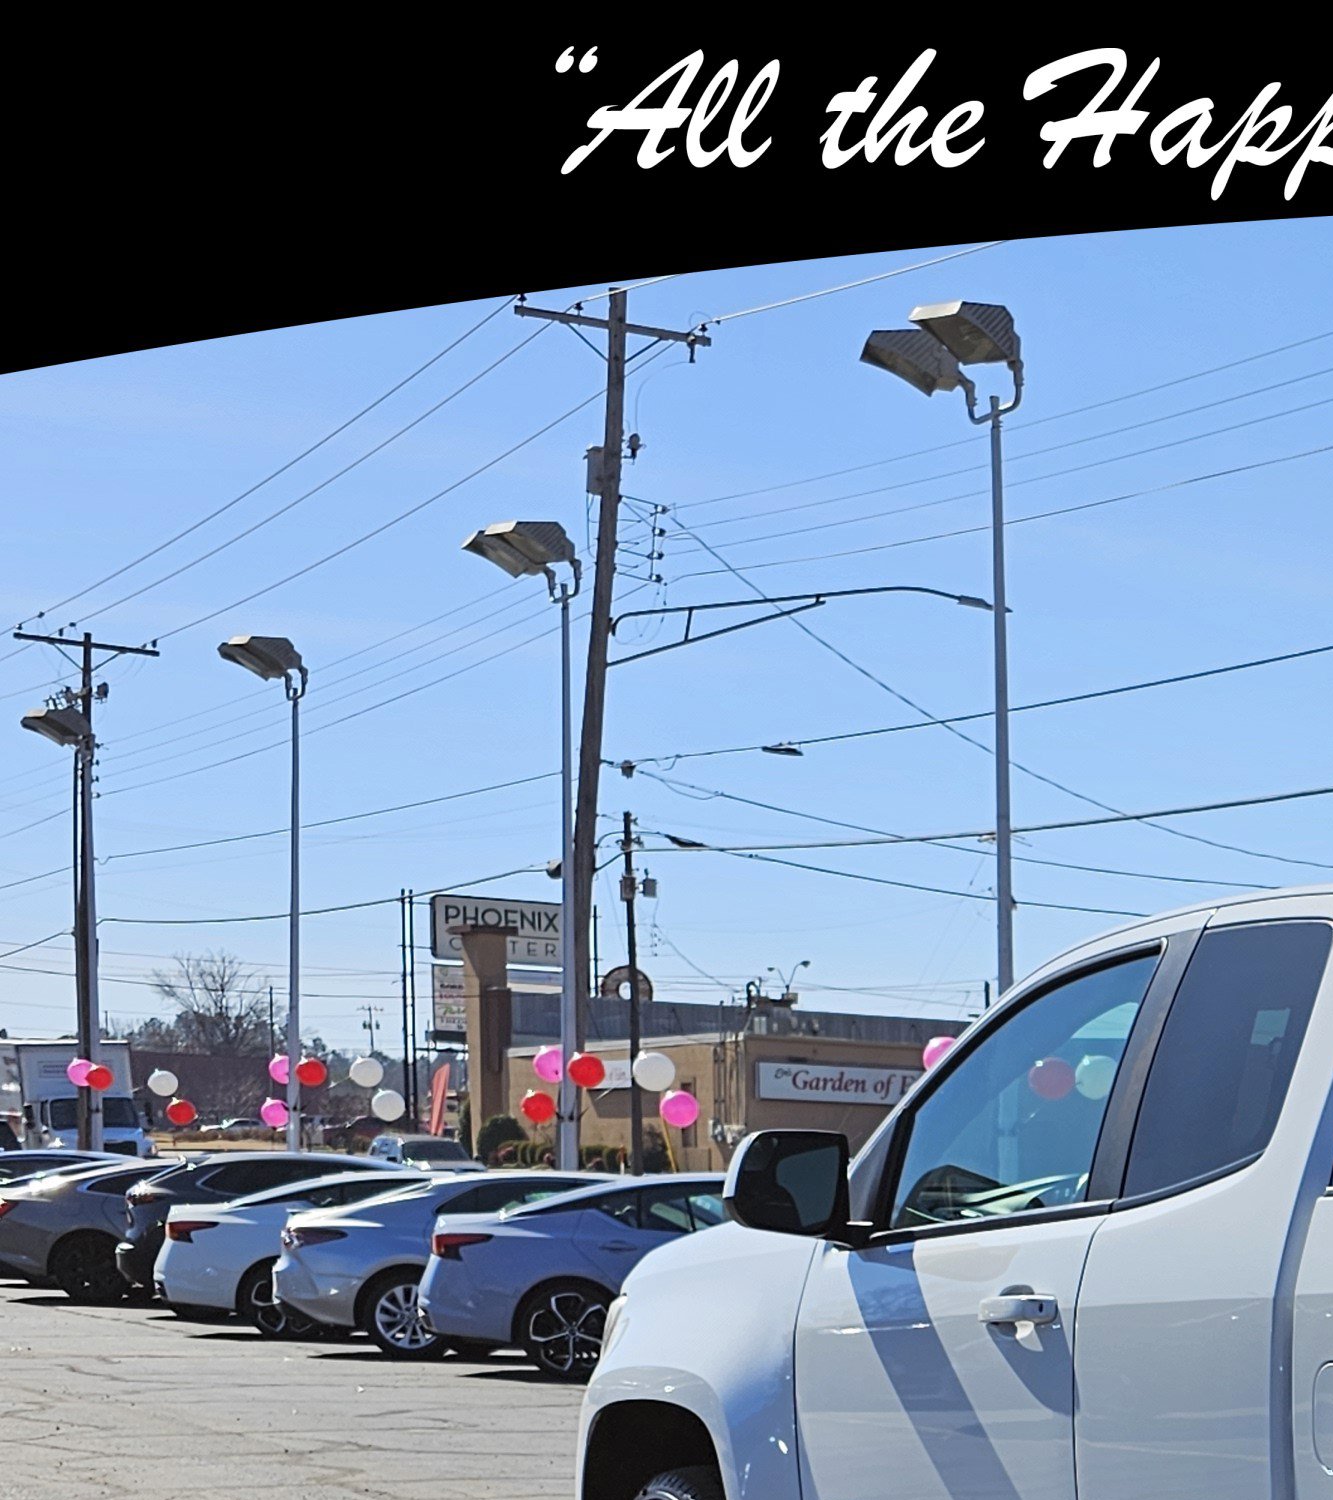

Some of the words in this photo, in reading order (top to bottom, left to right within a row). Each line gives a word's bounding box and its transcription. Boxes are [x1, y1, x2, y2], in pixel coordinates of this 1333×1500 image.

[444, 904, 559, 933] PHOENIX
[449, 936, 557, 958] CTER
[792, 1070, 866, 1093] Garden
[873, 1074, 897, 1099] of
